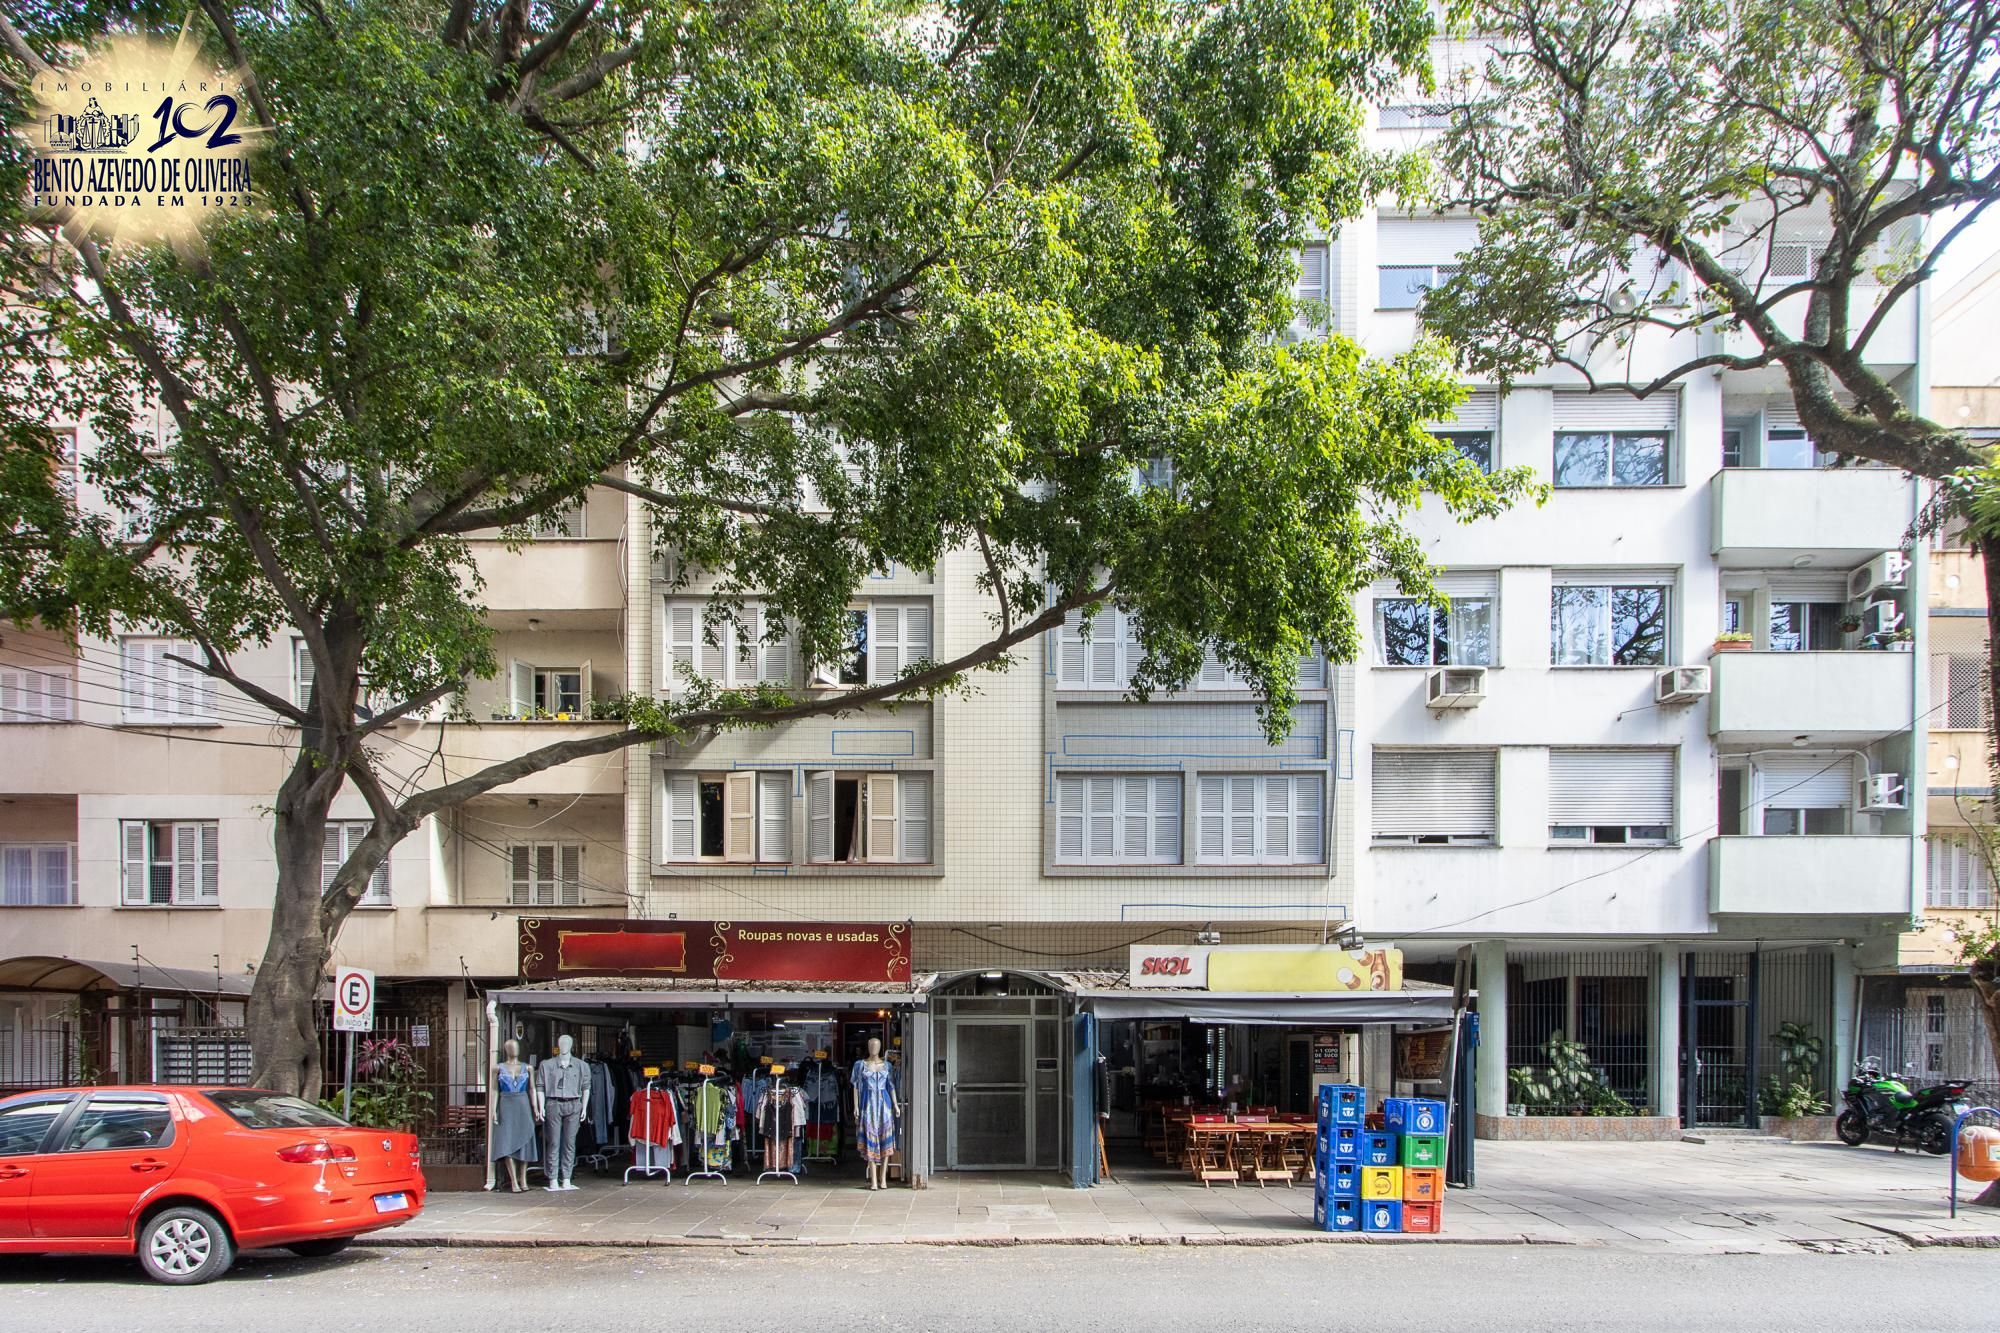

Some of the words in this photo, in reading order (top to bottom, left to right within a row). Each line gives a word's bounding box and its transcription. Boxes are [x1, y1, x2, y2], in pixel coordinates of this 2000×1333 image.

[738, 929, 783, 943] Roupas
[786, 931, 822, 941] novas
[826, 932, 833, 941] e
[837, 931, 879, 942] usadas
[1141, 956, 1192, 976] SKOL
[349, 982, 360, 1006] E
